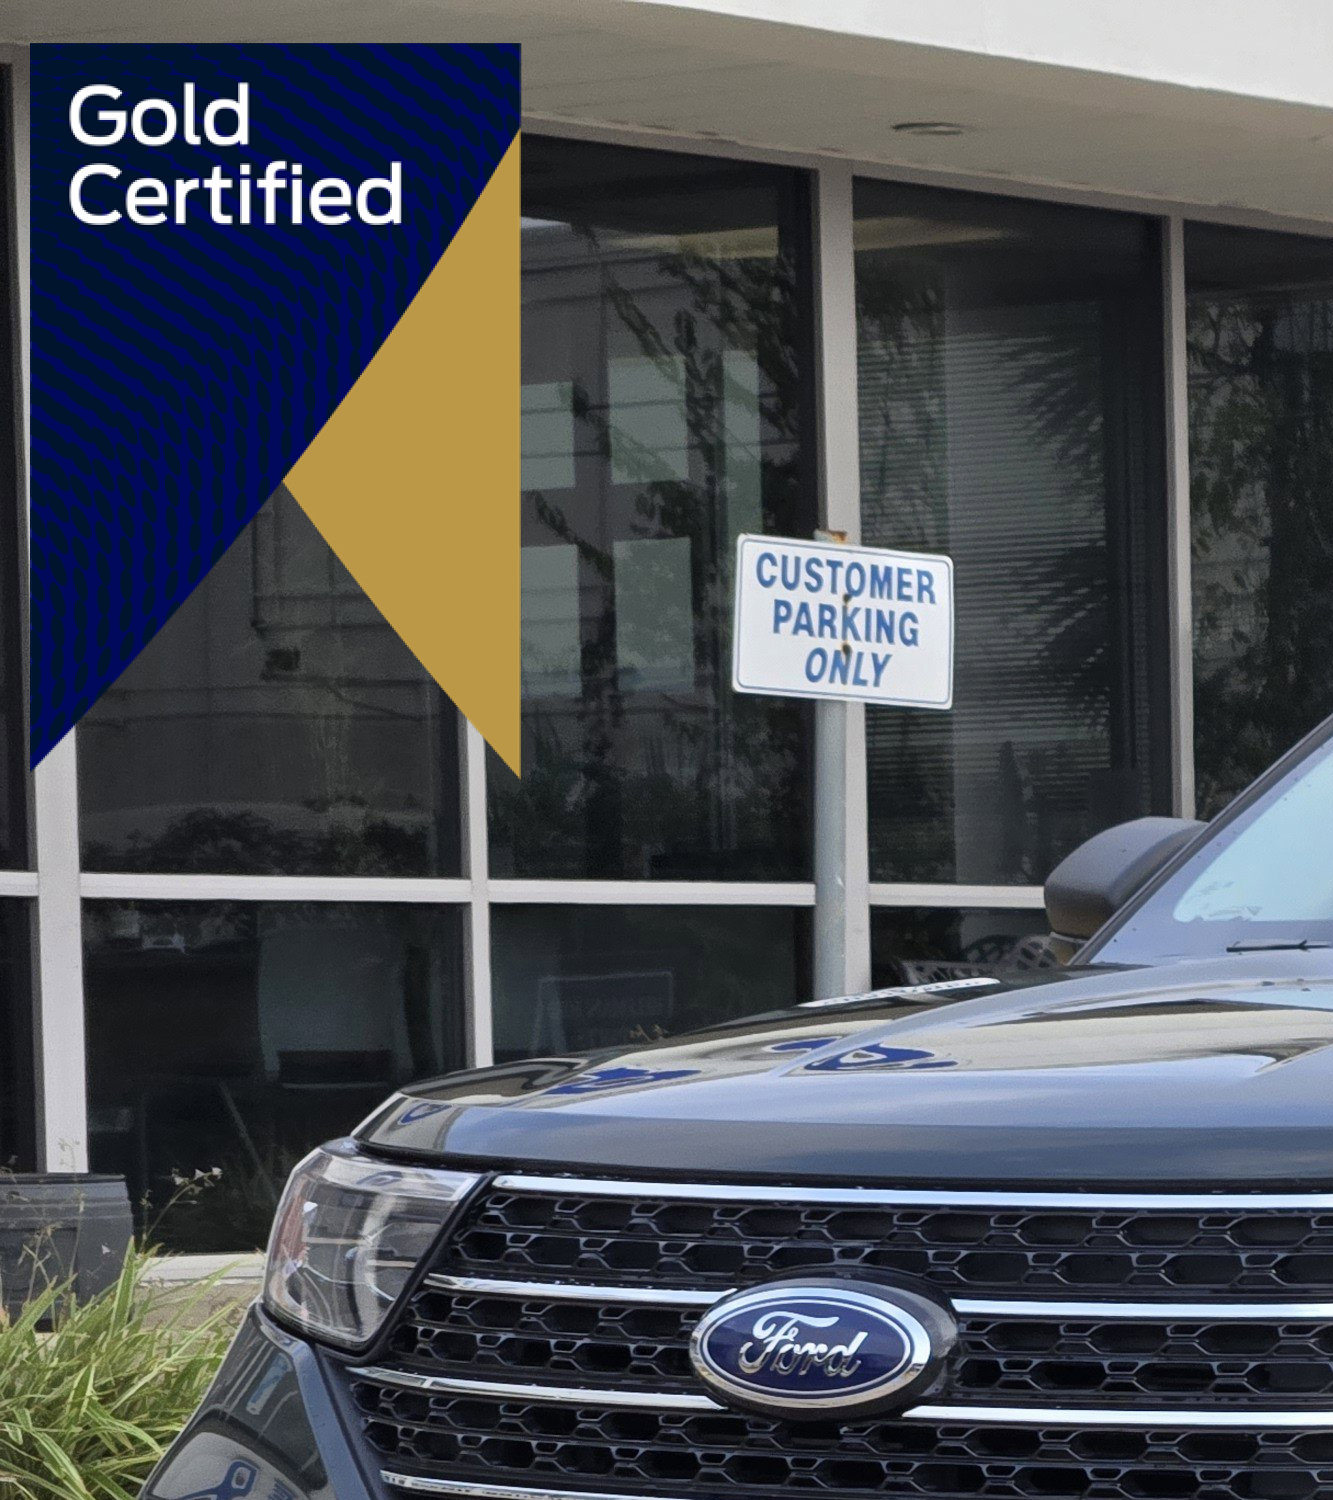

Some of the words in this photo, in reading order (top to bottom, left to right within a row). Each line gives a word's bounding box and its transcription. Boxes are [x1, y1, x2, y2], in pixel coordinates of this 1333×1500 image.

[756, 552, 937, 605] CUSTOMER
[772, 599, 920, 646] PARKING
[805, 647, 892, 689] ONLY
[739, 1310, 869, 1377] Ford
